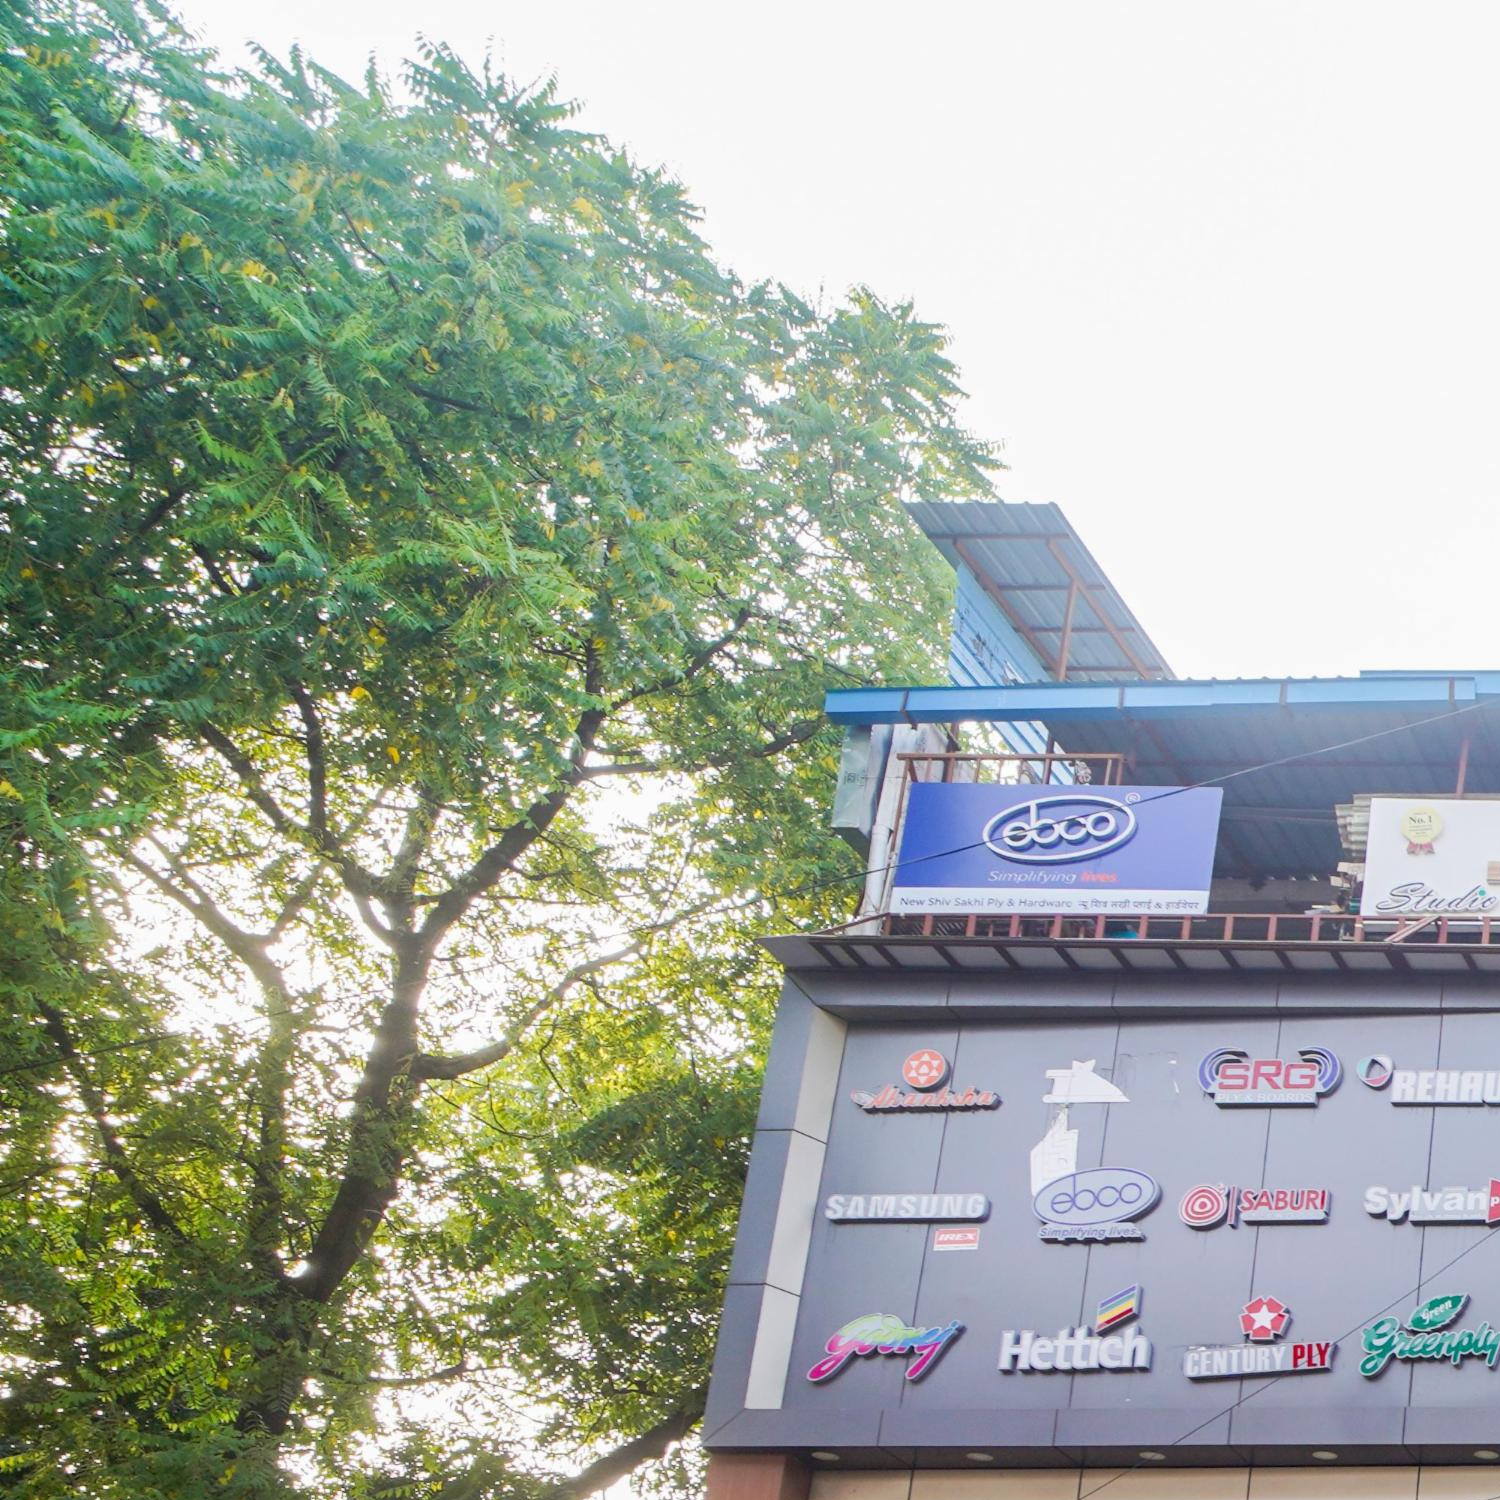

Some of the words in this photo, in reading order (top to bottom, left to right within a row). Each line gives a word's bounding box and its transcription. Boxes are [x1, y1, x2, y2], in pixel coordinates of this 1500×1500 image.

[1003, 801, 1117, 849] ebco
[988, 870, 1077, 886] Simplifying
[900, 897, 924, 907] New
[928, 897, 950, 907] Shiv
[954, 897, 984, 907] Sakhi
[987, 898, 1003, 910] Ply
[1007, 899, 1017, 908] &
[1019, 898, 1072, 908] Hardware
[1376, 882, 1497, 912] Studio
[1218, 1060, 1317, 1091] SRG
[825, 1194, 987, 1220] SAMSUNG
[1051, 1174, 1142, 1214] ebco
[1240, 1189, 1327, 1212] SABURI
[1365, 1186, 1486, 1221] Sylvan
[938, 1231, 977, 1243] IREX
[1038, 1227, 1107, 1240] Simplifying
[807, 1313, 966, 1381] Godrej
[998, 1326, 1150, 1372] Hettich
[1185, 1346, 1286, 1377] CENTURY
[1292, 1341, 1331, 1368] PLY
